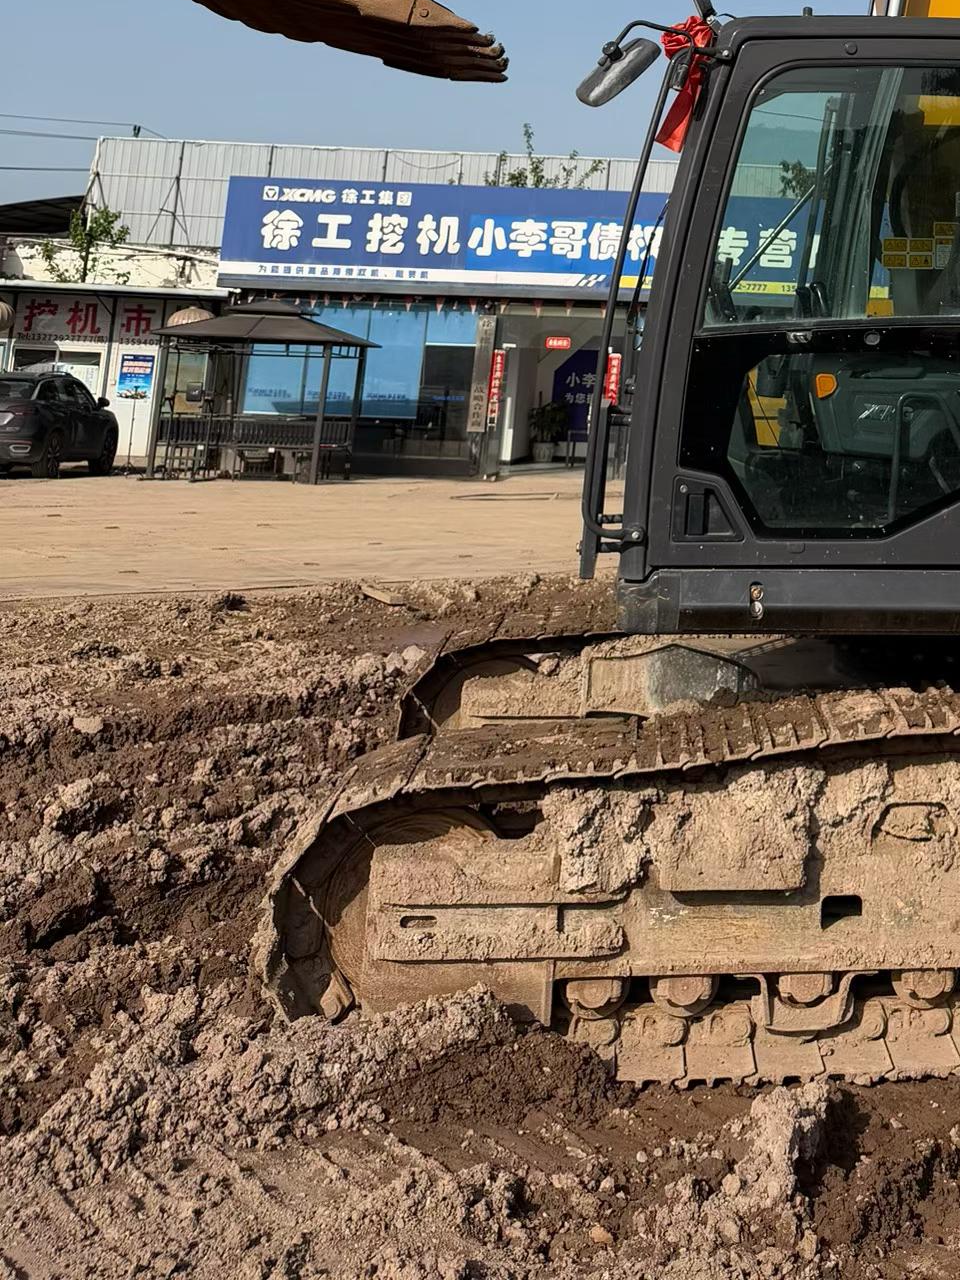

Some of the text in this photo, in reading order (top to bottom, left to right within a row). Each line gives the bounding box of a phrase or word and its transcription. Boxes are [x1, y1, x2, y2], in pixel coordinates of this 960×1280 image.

[278, 188, 412, 206] XCMG 徐工集团
[261, 209, 461, 255] 徐工挖机
